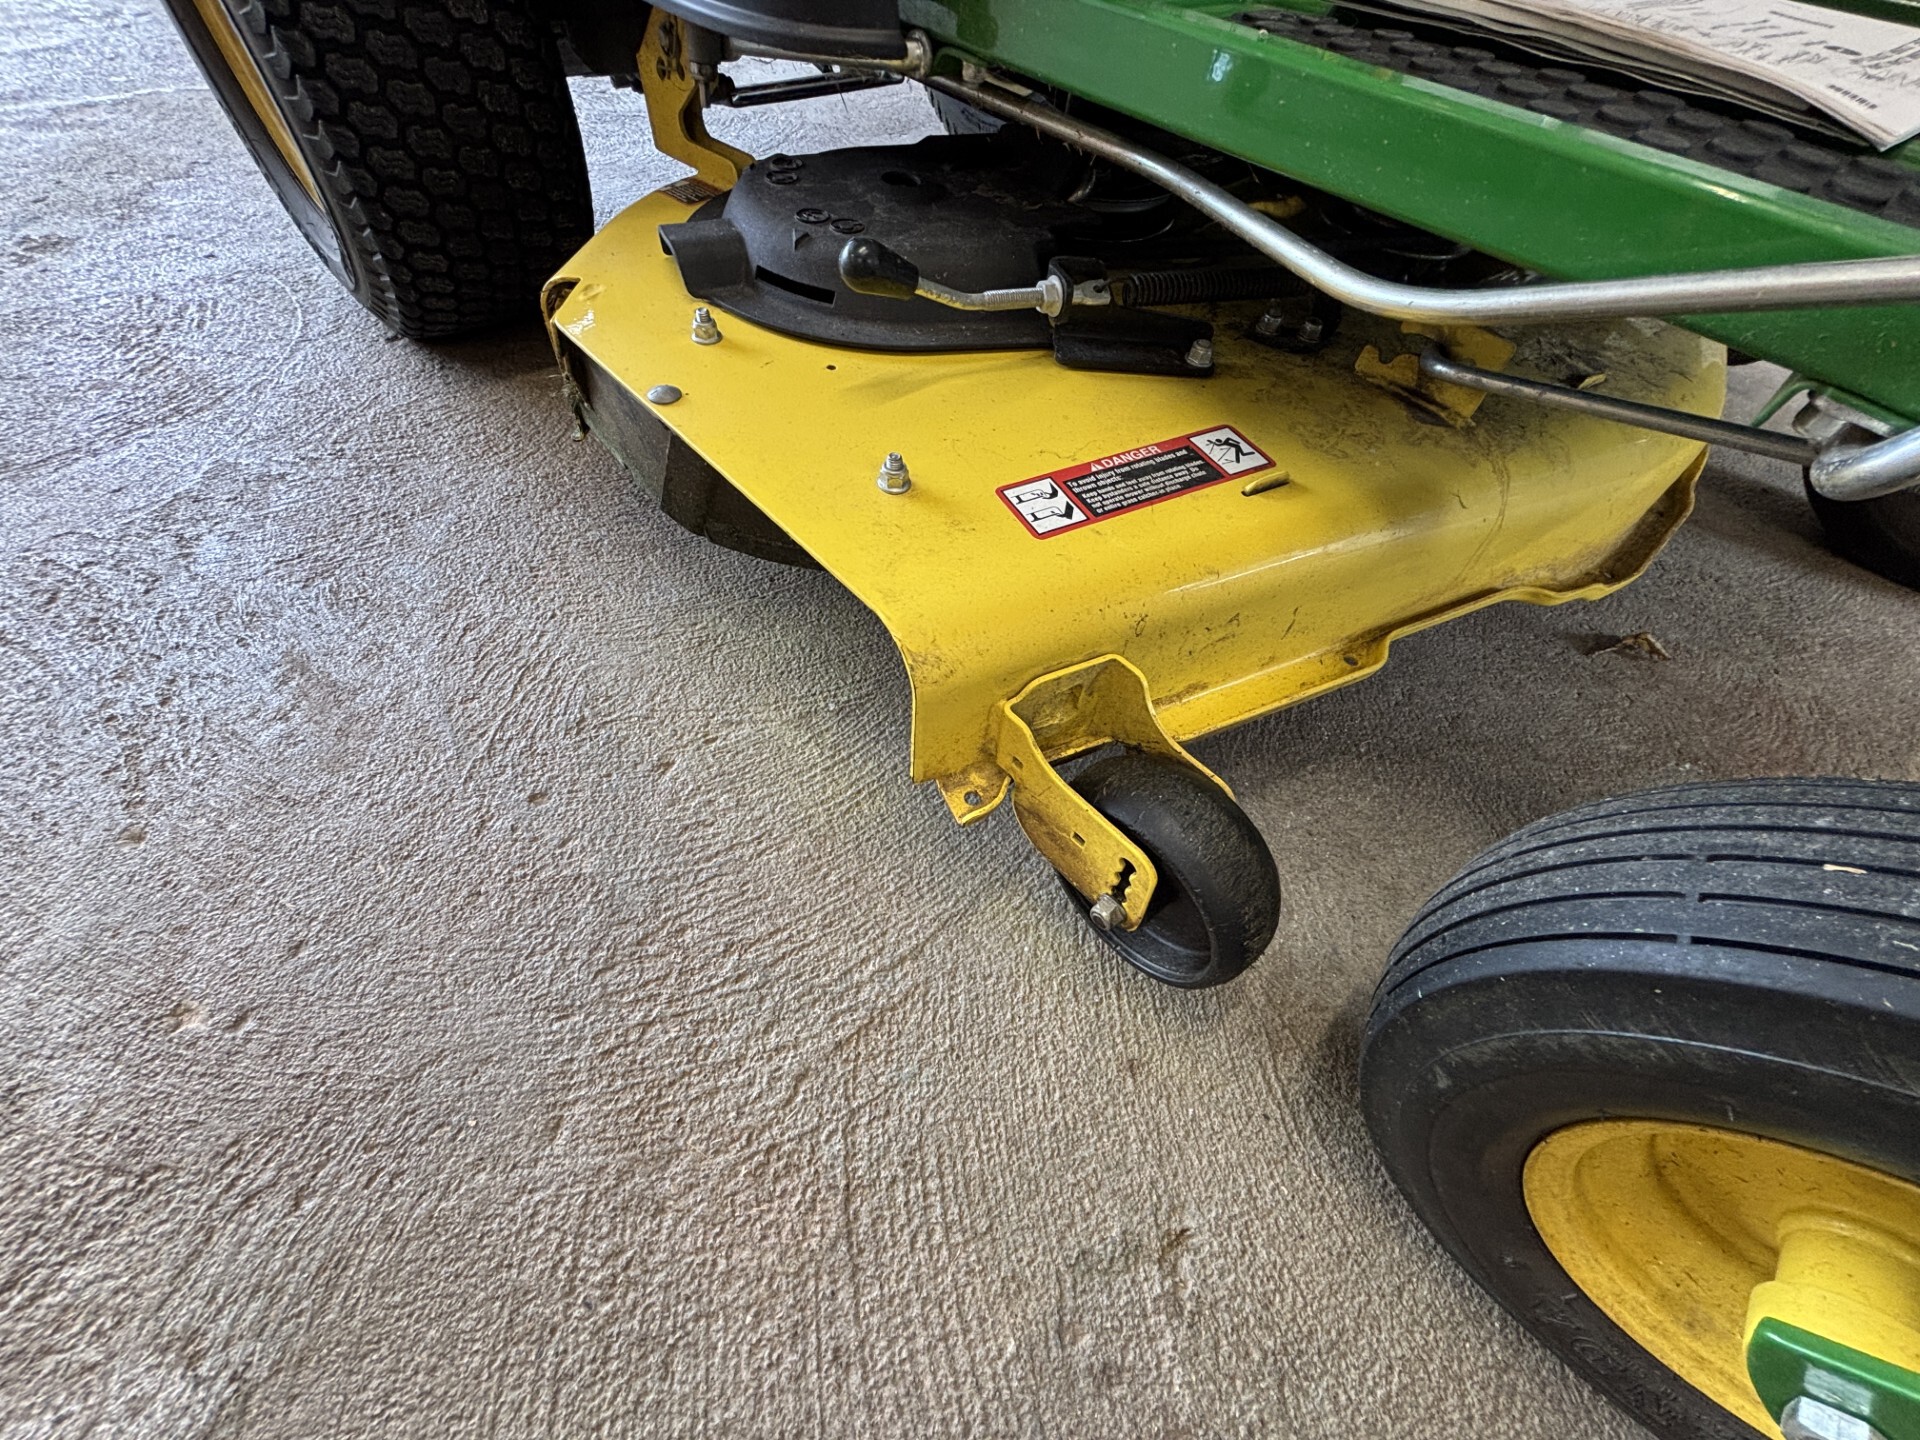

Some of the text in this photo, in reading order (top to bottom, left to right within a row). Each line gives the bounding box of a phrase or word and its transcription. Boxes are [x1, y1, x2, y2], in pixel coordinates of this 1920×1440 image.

[1066, 480, 1078, 488] To
[1076, 475, 1097, 485] avoid
[1094, 469, 1116, 480] injury
[1113, 464, 1131, 474] from
[1173, 448, 1188, 456] and
[1101, 445, 1161, 468] DANGER
[1072, 482, 1098, 493] thrown
